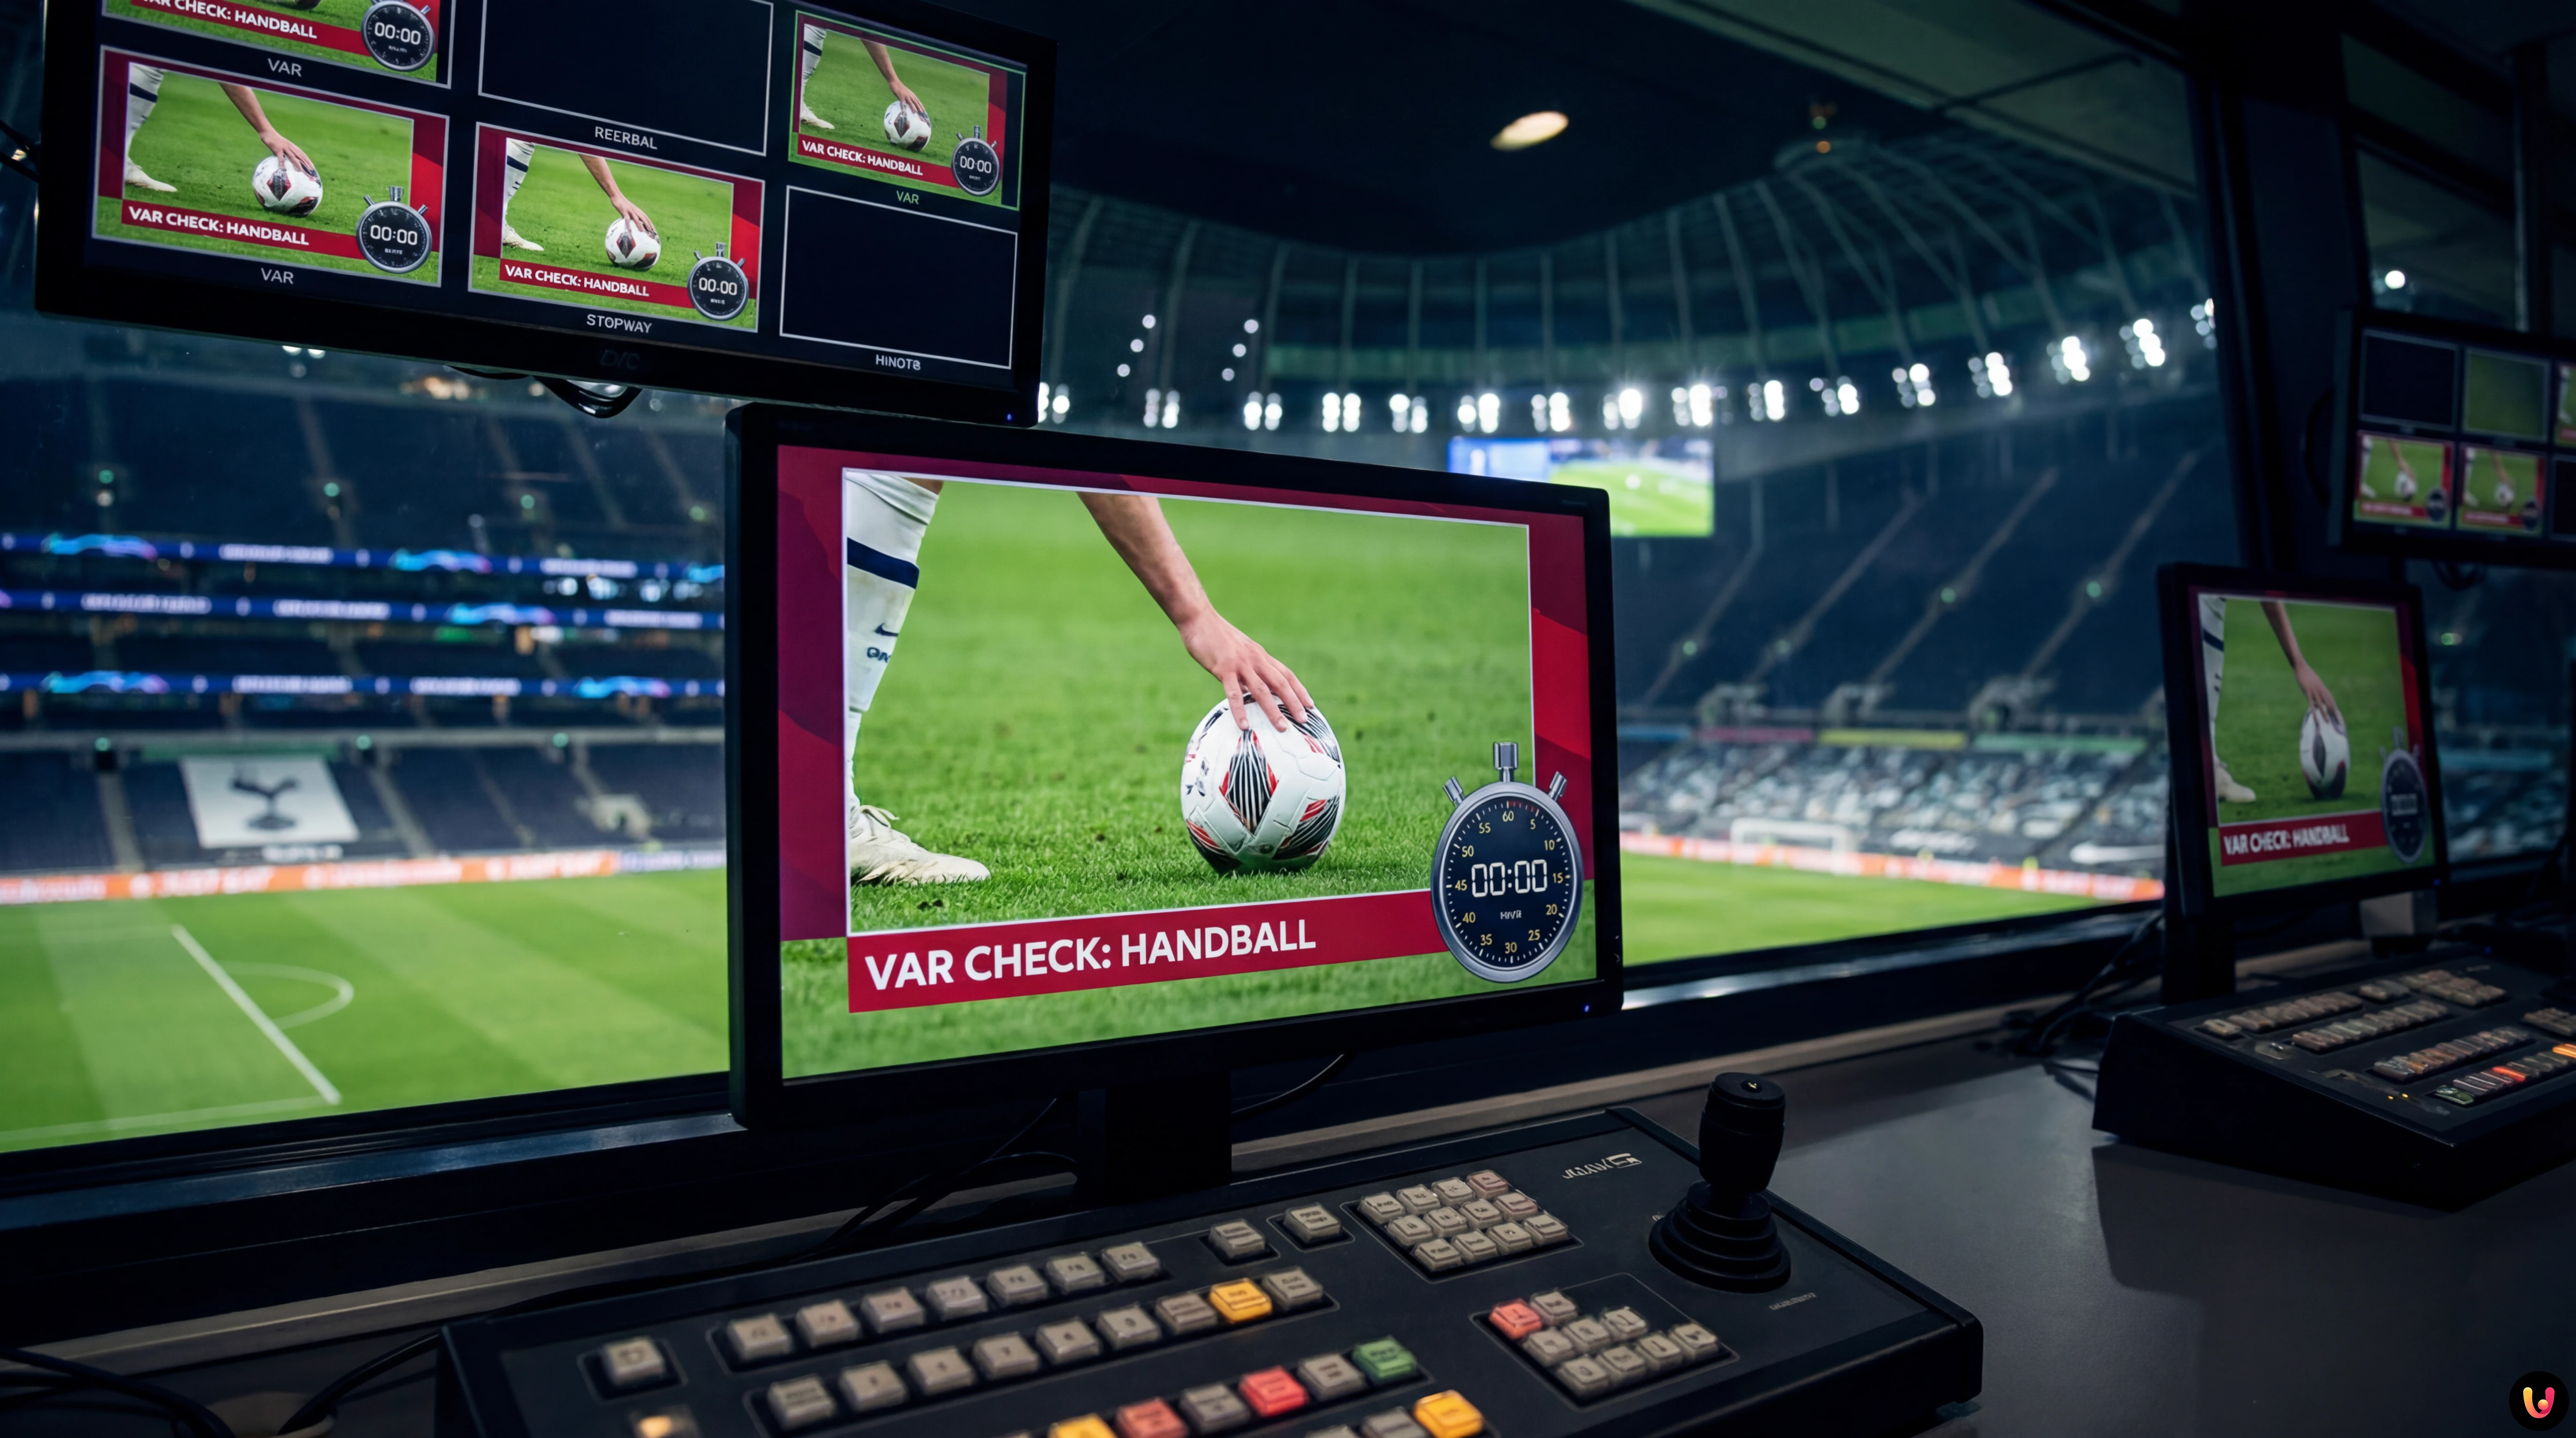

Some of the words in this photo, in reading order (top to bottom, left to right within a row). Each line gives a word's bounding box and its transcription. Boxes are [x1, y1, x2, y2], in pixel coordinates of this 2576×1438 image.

[235, 10, 317, 39] HANDBALL
[374, 22, 421, 45] 00:00
[267, 58, 302, 77] VAR
[595, 126, 658, 150] REERBAL
[802, 140, 825, 154] VAR
[827, 146, 866, 164] CHECK:
[867, 154, 923, 176] HANDBALL
[896, 191, 919, 205] VAR
[128, 206, 163, 224] VAR
[165, 213, 224, 233] CHECK:
[227, 221, 310, 246] HANDBALL
[370, 225, 418, 246] 00:00
[260, 267, 294, 285] VAR
[505, 264, 533, 279] VAR
[534, 270, 582, 287] CHECK:
[584, 277, 650, 297] HANDBALL
[586, 314, 652, 334] STOPWAY
[1502, 810, 1514, 822] 60
[1478, 822, 1491, 834] 55
[1530, 819, 1537, 829] 5
[1462, 845, 1474, 858] 50
[1544, 840, 1555, 851] 10
[1455, 879, 1468, 891] 45
[1471, 859, 1548, 898] 00:00
[1552, 872, 1564, 884] 15
[1546, 903, 1558, 915] 20
[1462, 912, 1476, 923] 40
[1480, 933, 1493, 946] 35
[1528, 929, 1541, 941] 25
[864, 949, 955, 990] VAR
[964, 936, 1112, 982] CHECK:
[1121, 919, 1317, 967] HANDBALL
[1505, 942, 1517, 954] 30
